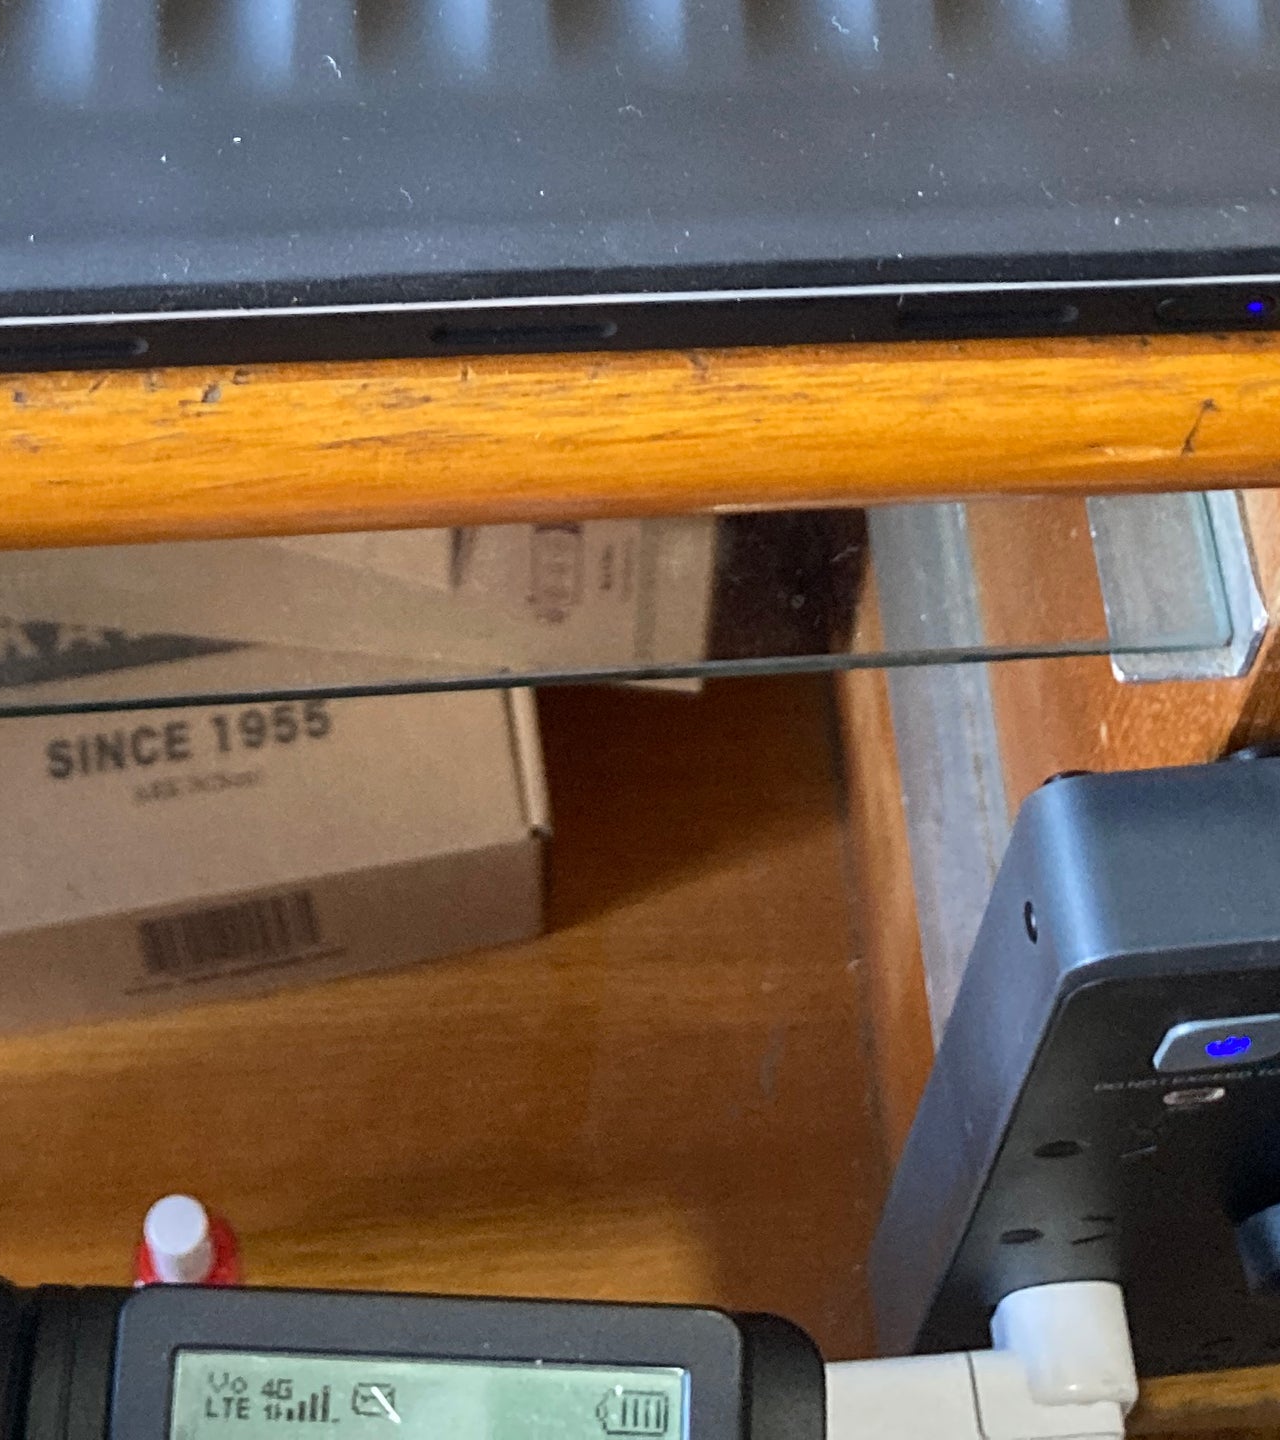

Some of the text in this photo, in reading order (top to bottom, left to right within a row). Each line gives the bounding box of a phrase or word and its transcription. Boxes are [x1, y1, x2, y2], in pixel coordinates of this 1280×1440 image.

[46, 697, 333, 780] SINCE 1955
[203, 1396, 251, 1420] LTE
